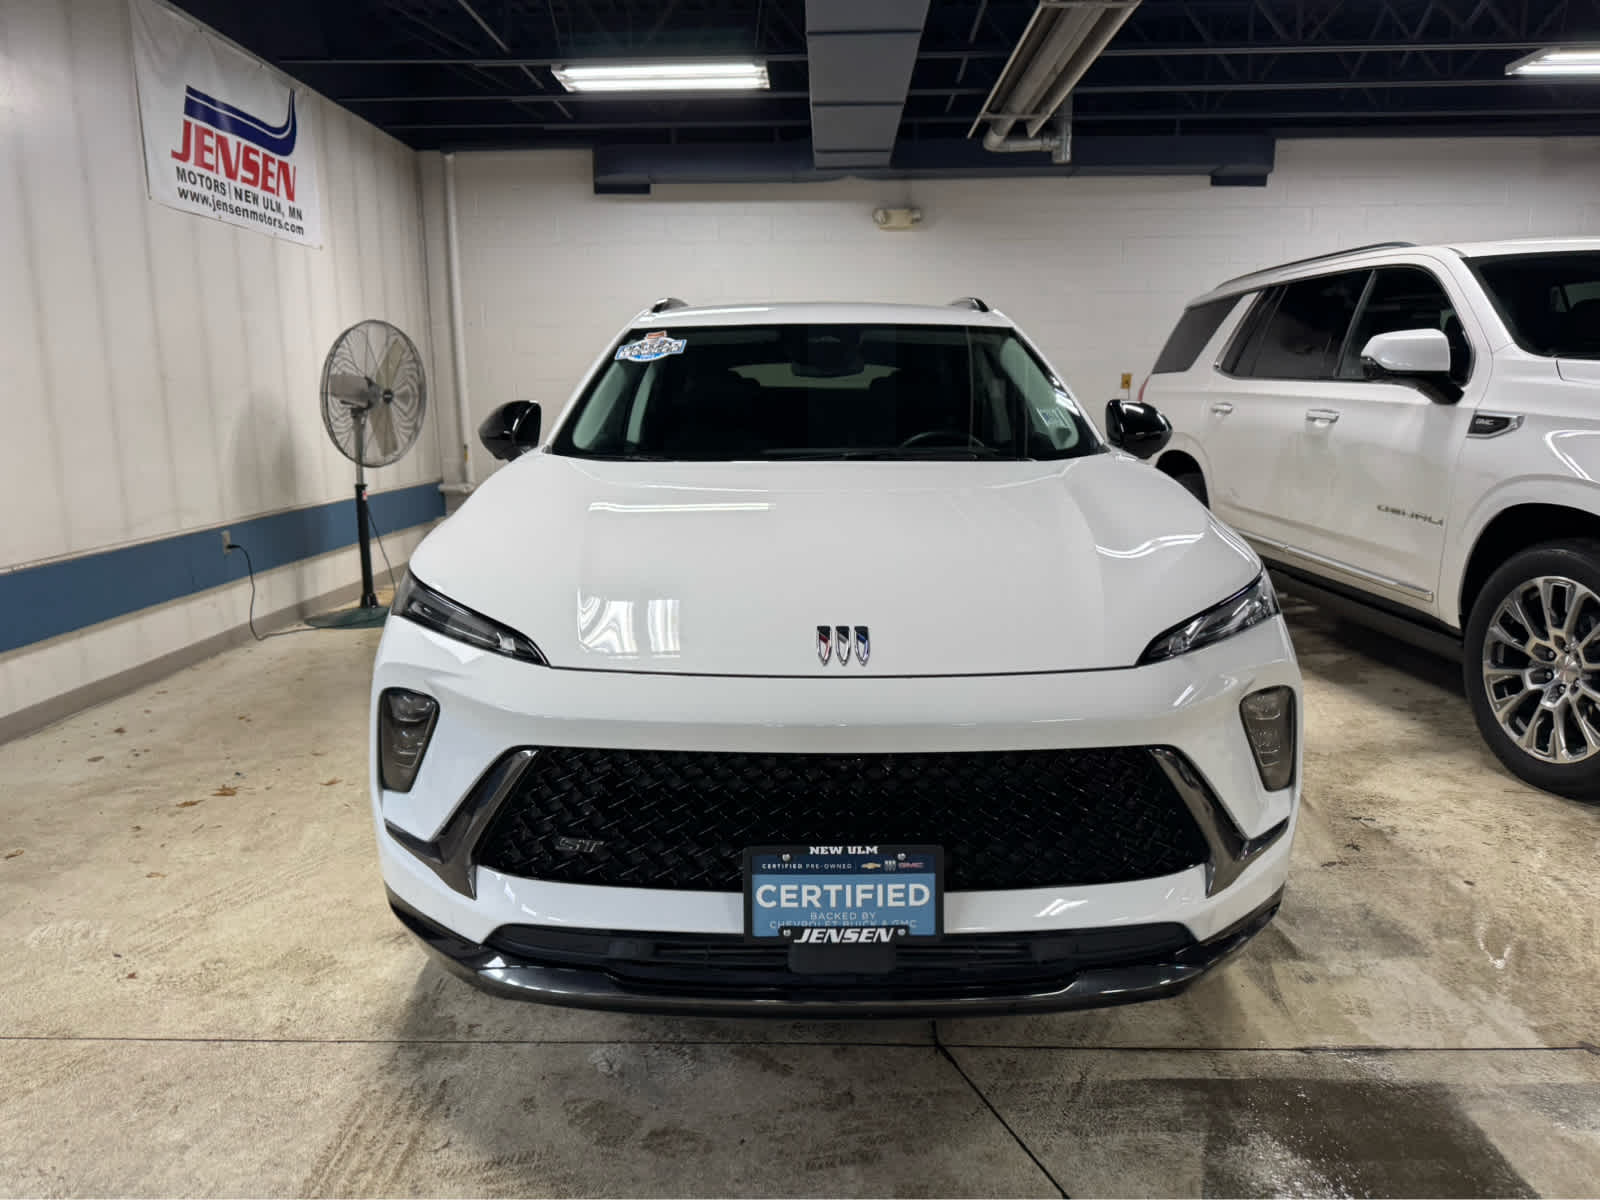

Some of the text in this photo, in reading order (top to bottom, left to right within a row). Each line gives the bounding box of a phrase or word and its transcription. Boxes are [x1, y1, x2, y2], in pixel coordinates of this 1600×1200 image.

[171, 119, 296, 202] JENSEN
[176, 166, 226, 196] MOTORS
[233, 186, 259, 207] NEW
[288, 205, 303, 221] MN
[177, 187, 304, 235] www.jensenmotors.com
[809, 846, 879, 855] NEW ULM
[756, 883, 930, 909] CERTIFIED
[810, 912, 876, 920] BACKED BY
[793, 927, 894, 943] JENSEN
